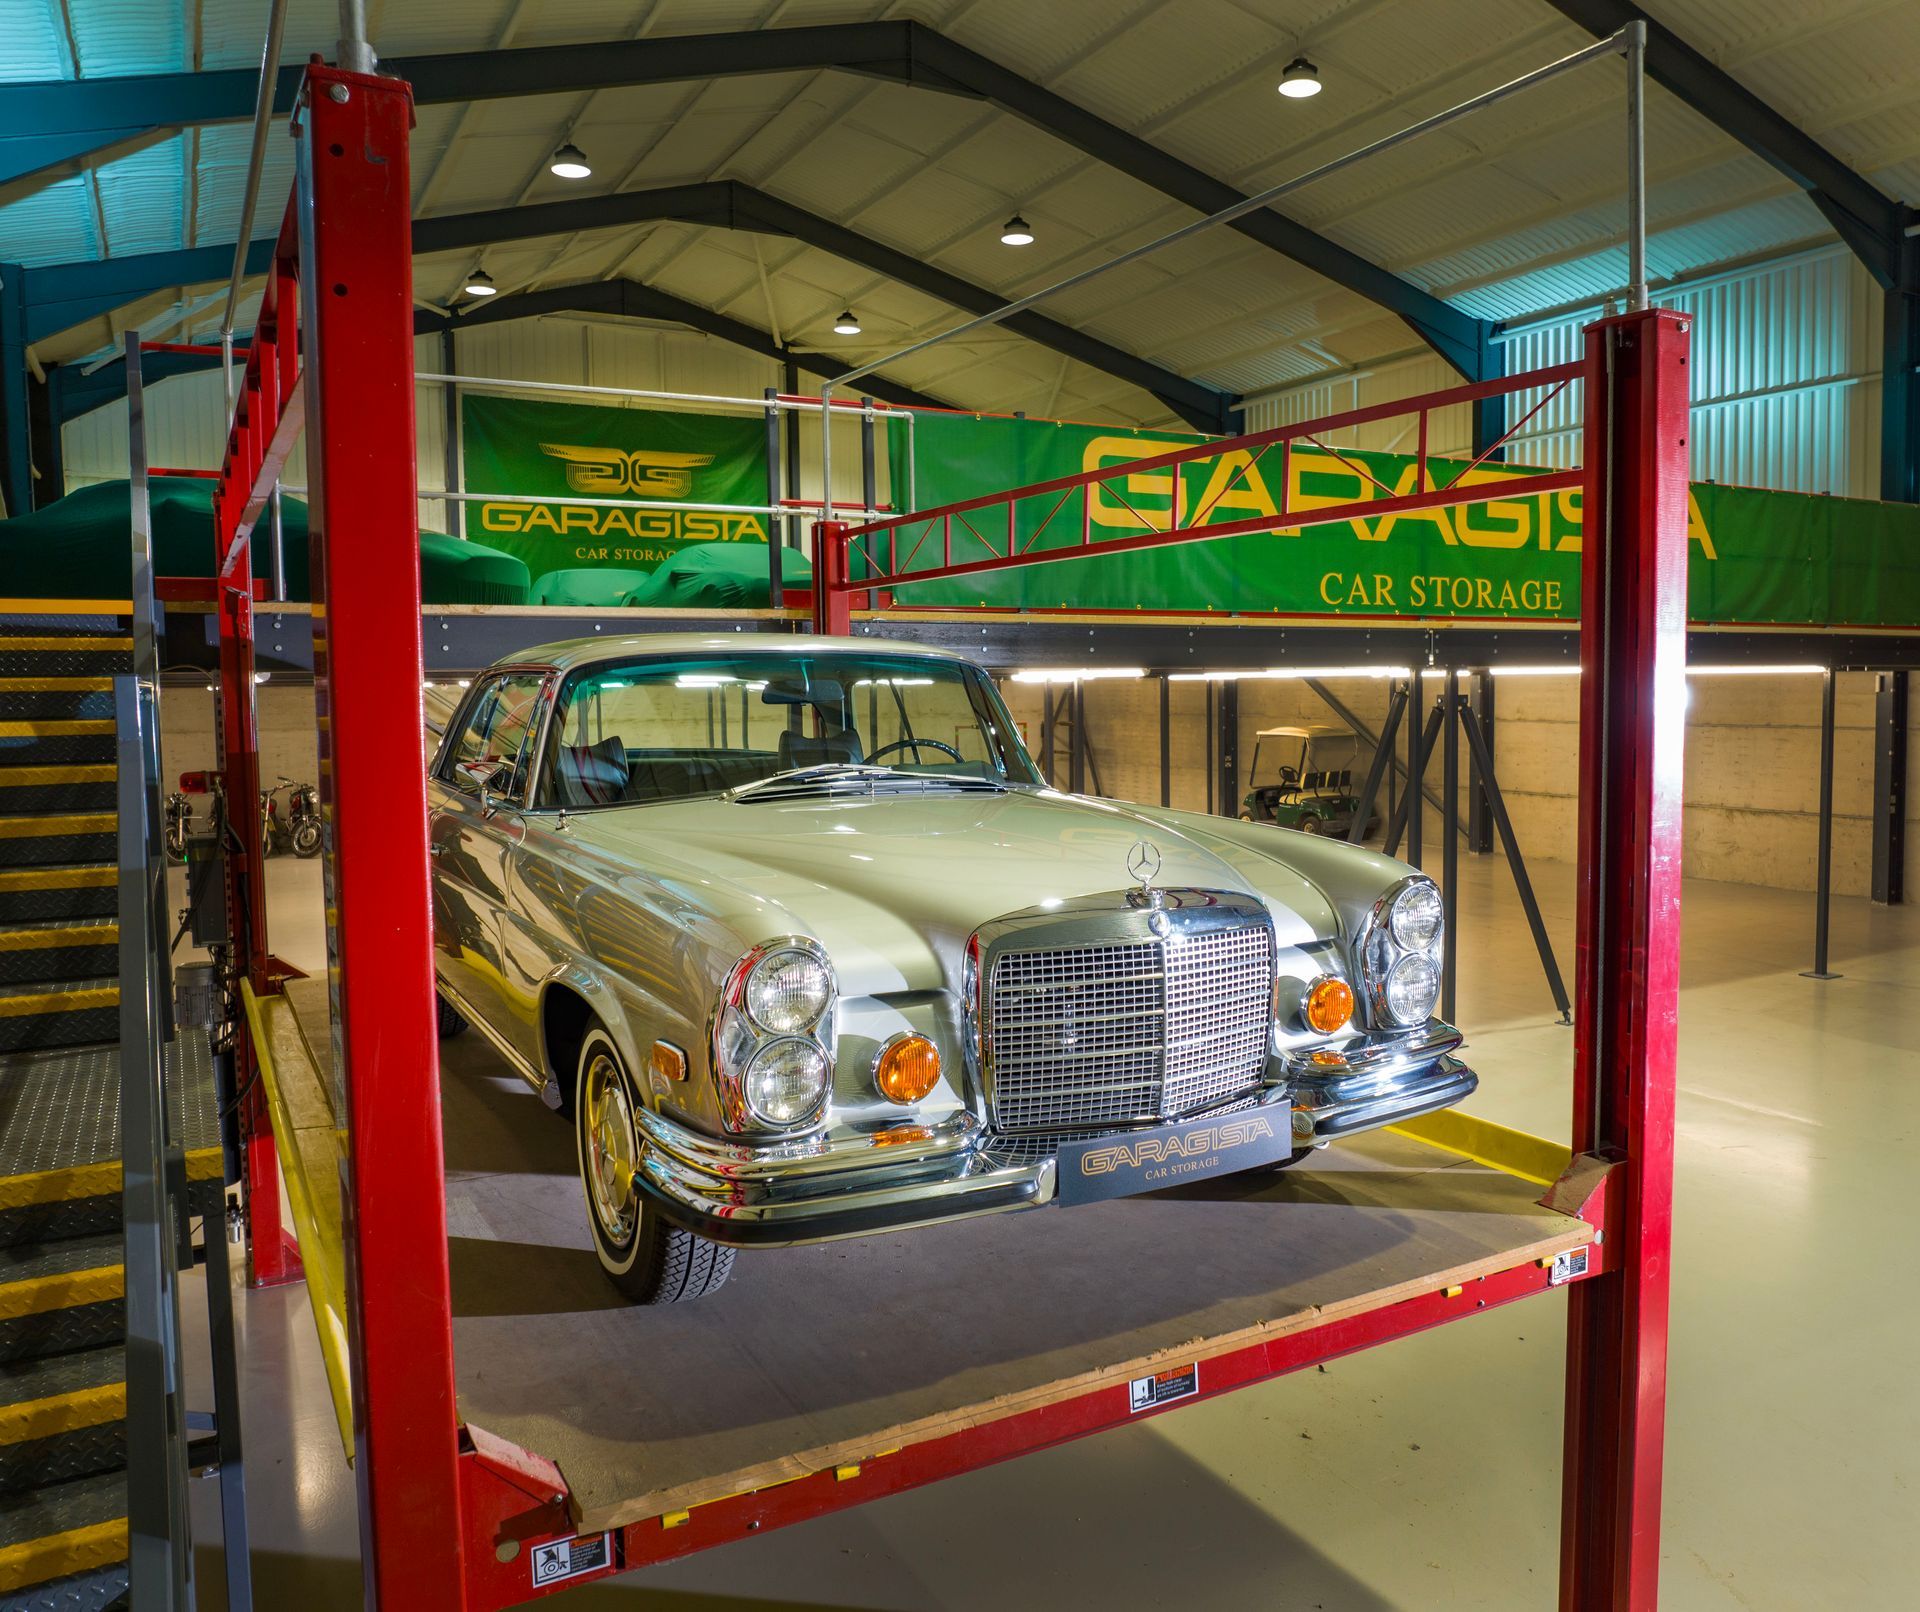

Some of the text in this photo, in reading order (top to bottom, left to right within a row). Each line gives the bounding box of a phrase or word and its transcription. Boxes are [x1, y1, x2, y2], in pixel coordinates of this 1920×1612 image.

[482, 502, 767, 542] GARAGISTA
[575, 547, 609, 560] CAR
[1320, 572, 1562, 610] CAR STORAGE
[1081, 1117, 1273, 1176] GARAGISTA
[1145, 1156, 1219, 1180] CAR STORAGE
